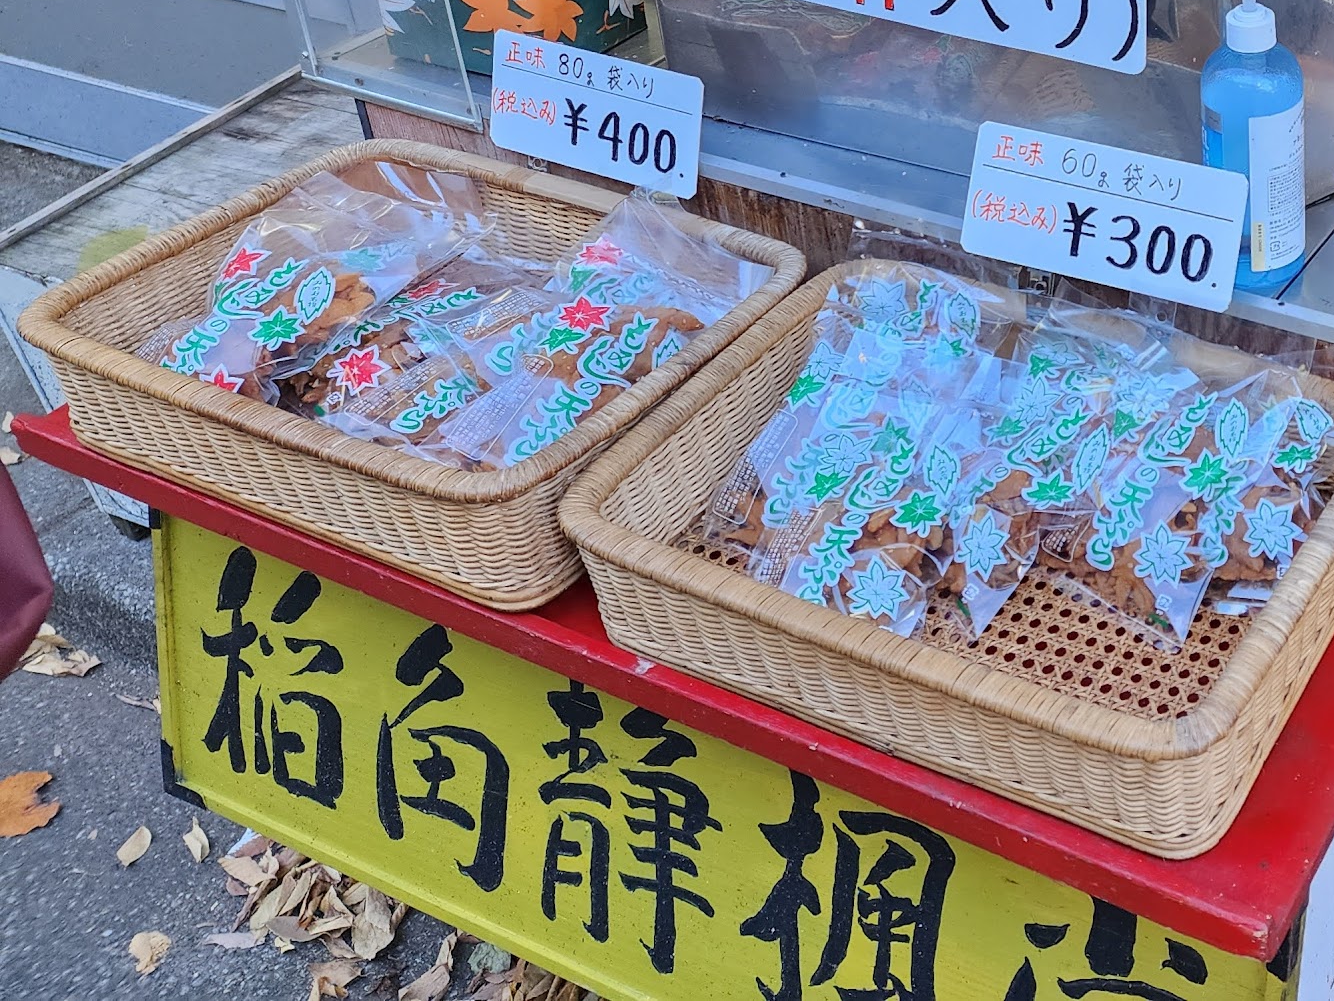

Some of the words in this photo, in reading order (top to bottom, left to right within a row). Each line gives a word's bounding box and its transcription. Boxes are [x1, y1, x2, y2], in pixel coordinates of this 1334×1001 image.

[505, 41, 545, 69] 正味
[607, 65, 654, 99] 袋入り
[493, 87, 557, 126] (税込み)
[992, 135, 1044, 167] 正味
[1123, 163, 1183, 201] 袋入り
[972, 189, 1058, 235] (税込み)
